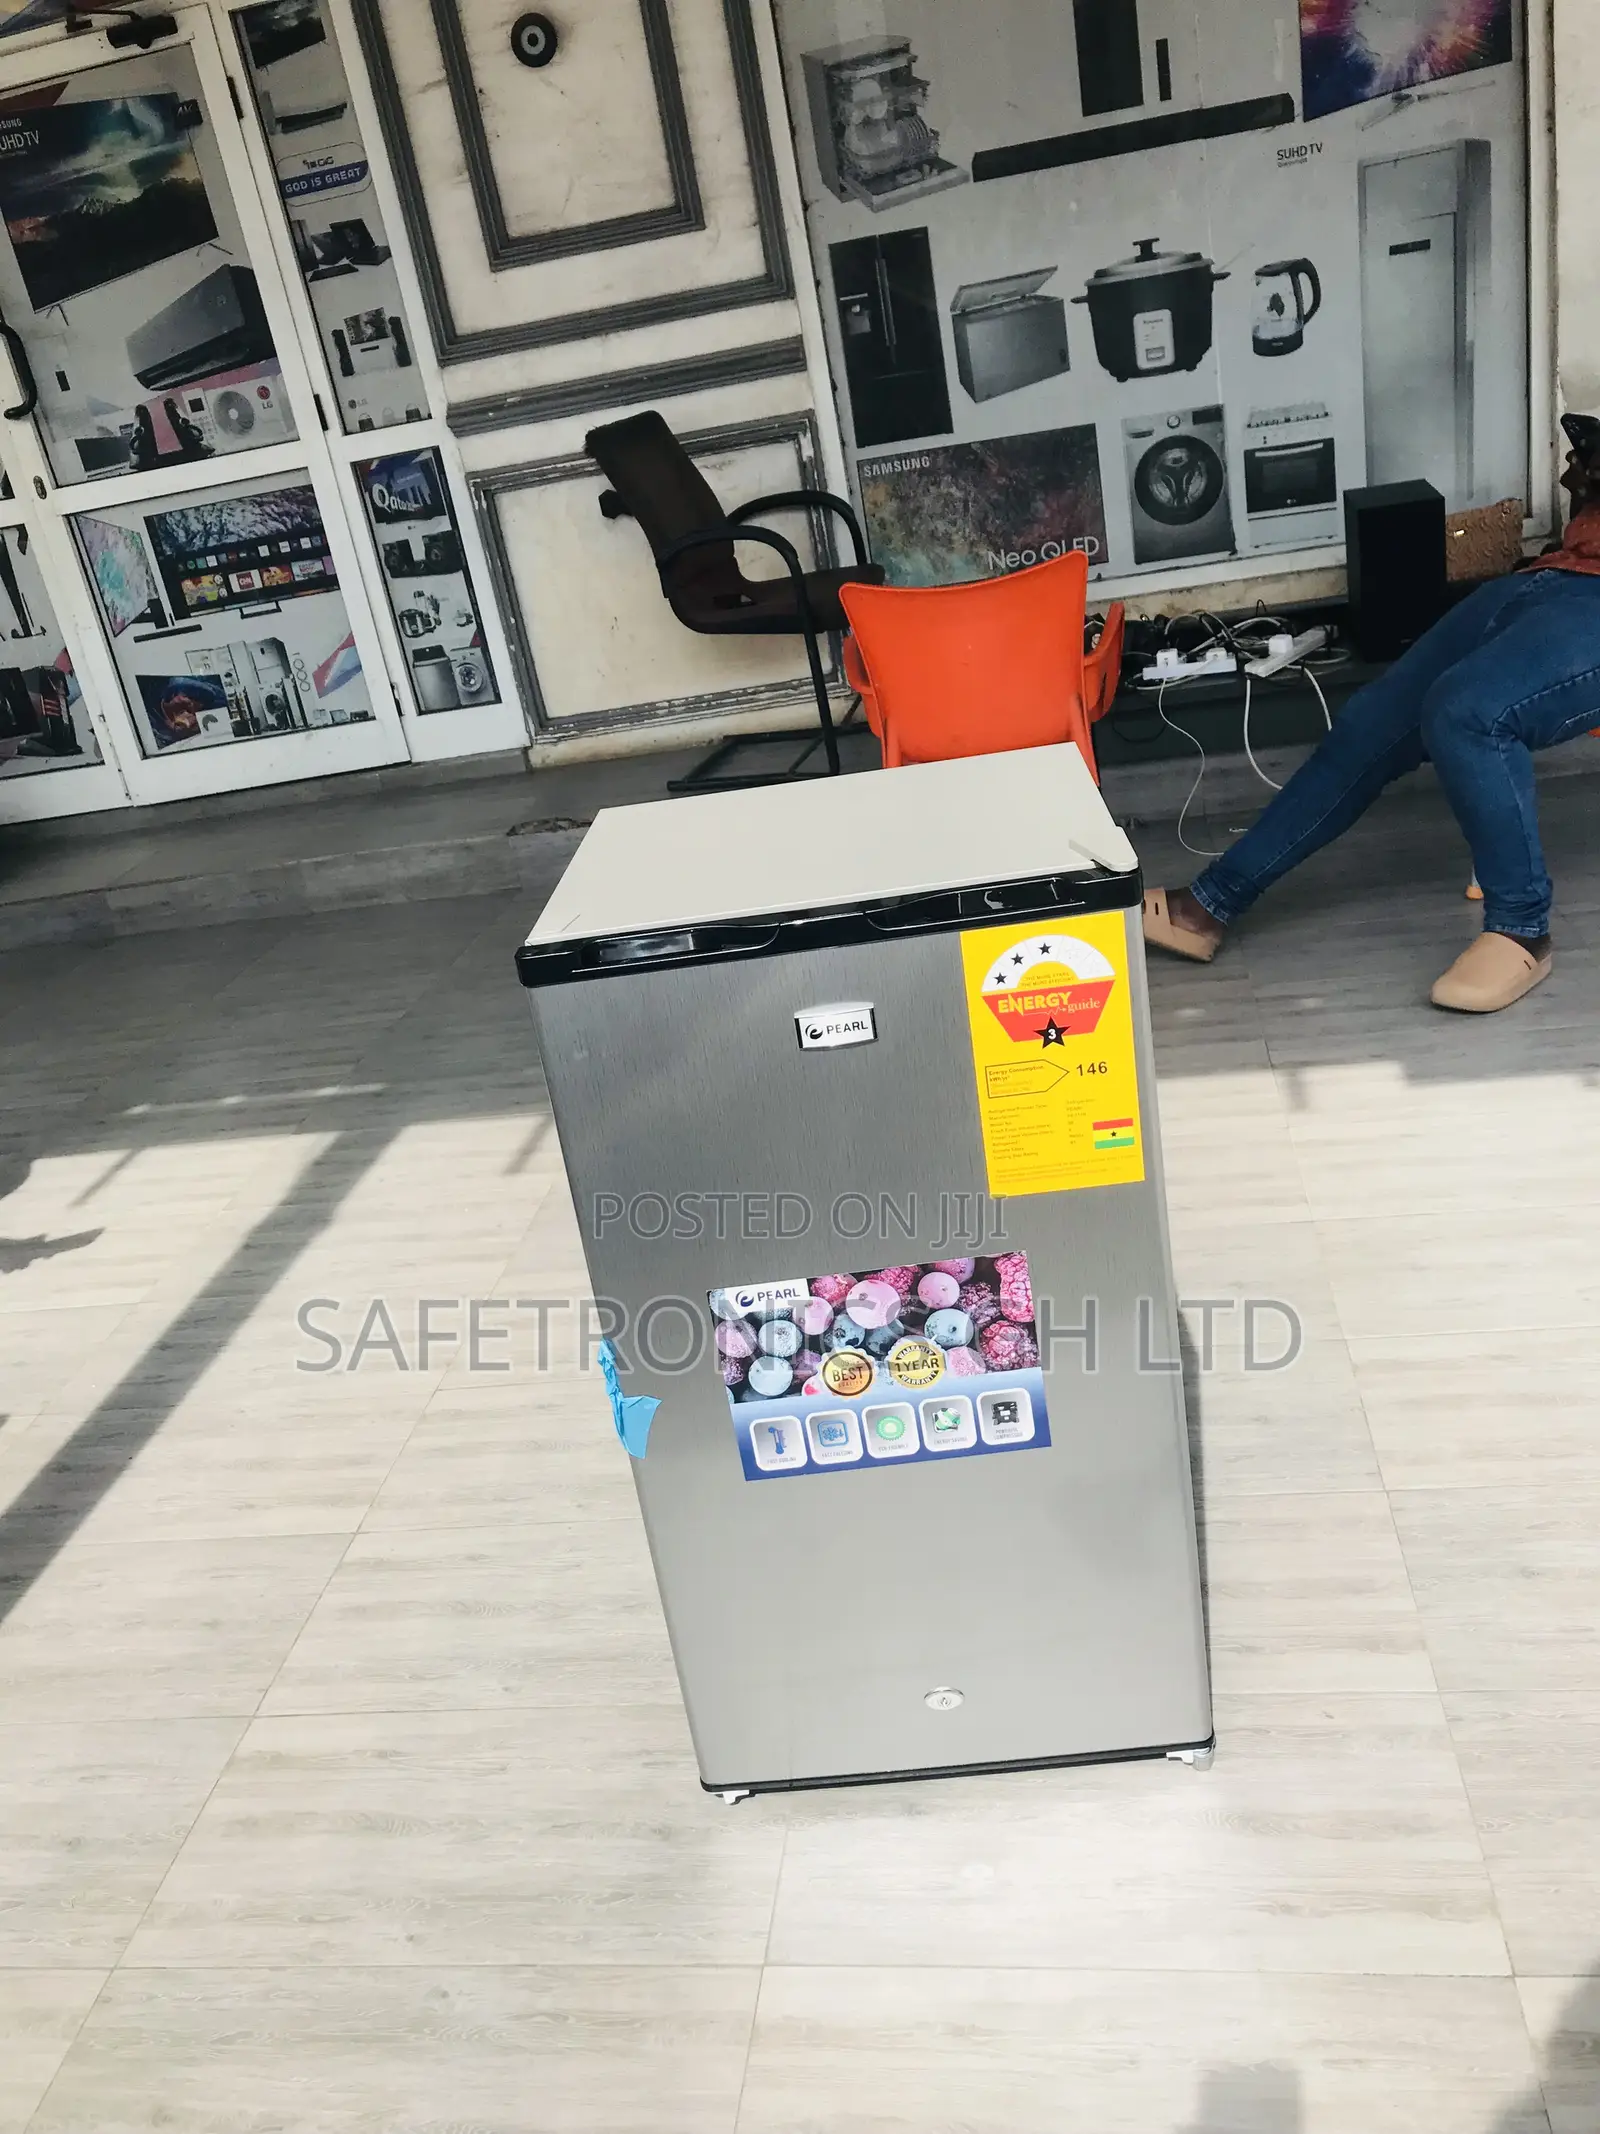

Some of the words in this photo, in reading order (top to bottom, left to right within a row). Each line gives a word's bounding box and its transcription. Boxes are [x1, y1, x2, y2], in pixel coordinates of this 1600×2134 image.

[23, 130, 39, 146] TV
[1277, 145, 1308, 161] SUHD
[1309, 142, 1323, 154] TV
[285, 181, 308, 193] GOD
[311, 177, 322, 187] IS
[325, 167, 361, 184] GREAT
[863, 456, 931, 478] SAMSUNG
[986, 550, 1037, 571] Neo
[997, 991, 1073, 1017] ENERGY
[1067, 997, 1101, 1013] guide
[826, 1020, 869, 1035] PEARL
[1047, 1028, 1057, 1040] 3
[1076, 1061, 1108, 1077] 146
[757, 1288, 801, 1302] PEARL
[894, 1362, 902, 1372] 1
[903, 1358, 941, 1372] YEAR
[832, 1366, 864, 1383] BEST
[899, 1372, 938, 1385] WARRANTY
